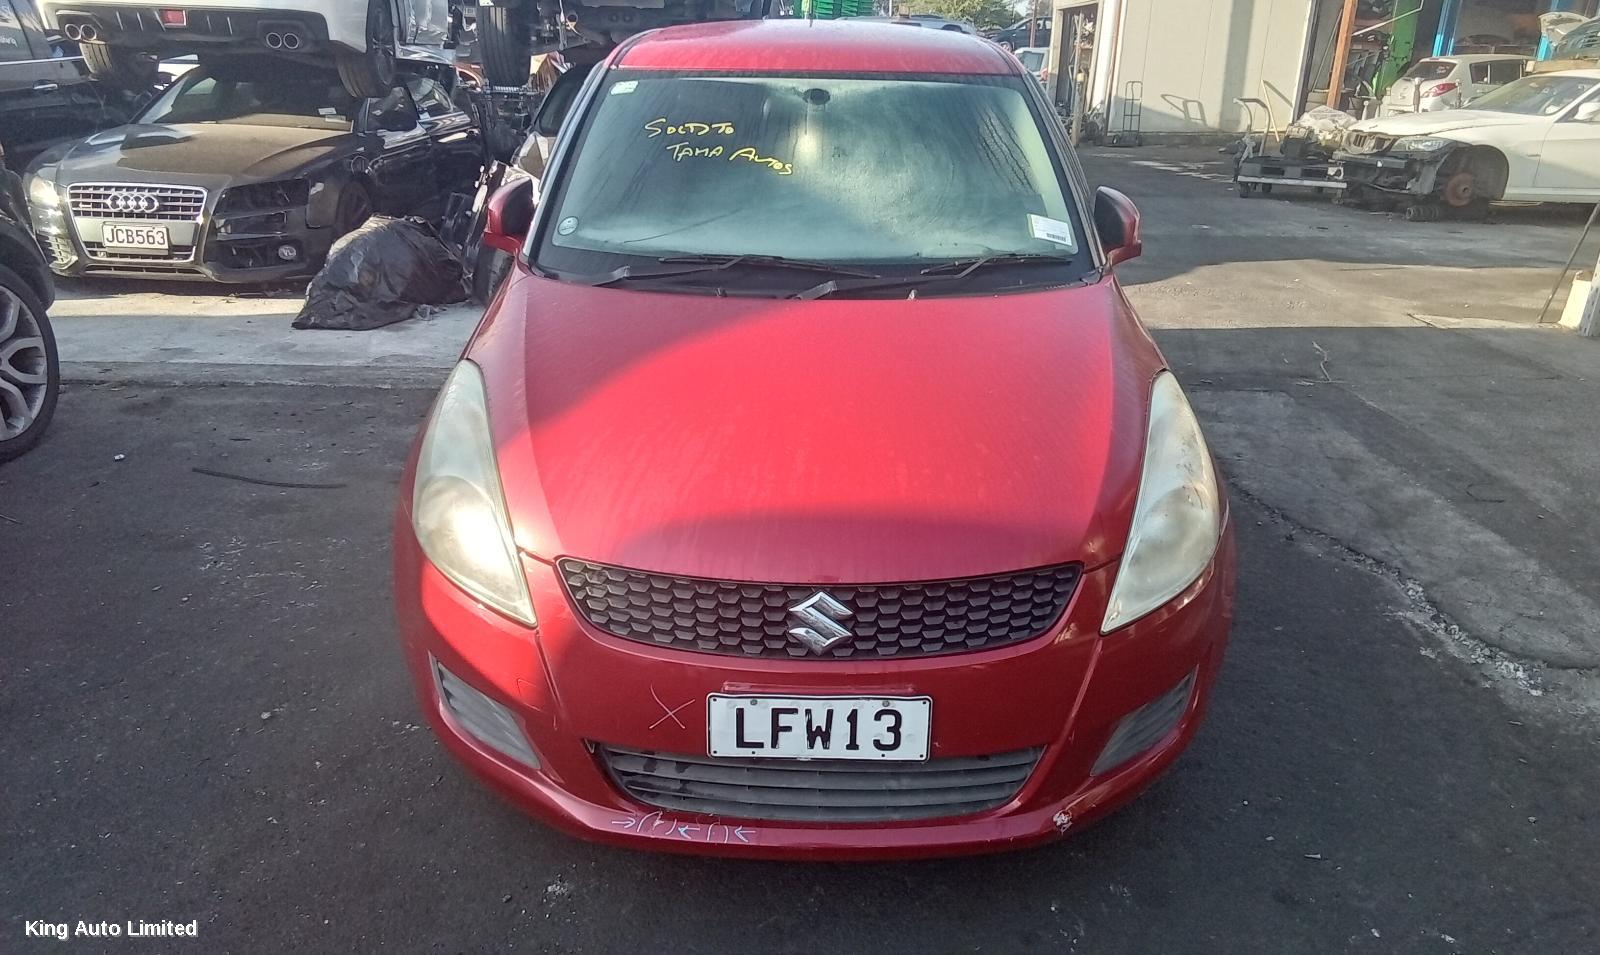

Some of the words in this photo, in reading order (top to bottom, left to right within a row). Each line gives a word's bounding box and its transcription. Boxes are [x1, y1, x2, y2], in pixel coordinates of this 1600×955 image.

[667, 142, 724, 161] TAMA
[106, 228, 166, 246] JCB563
[735, 707, 903, 752] LFW13
